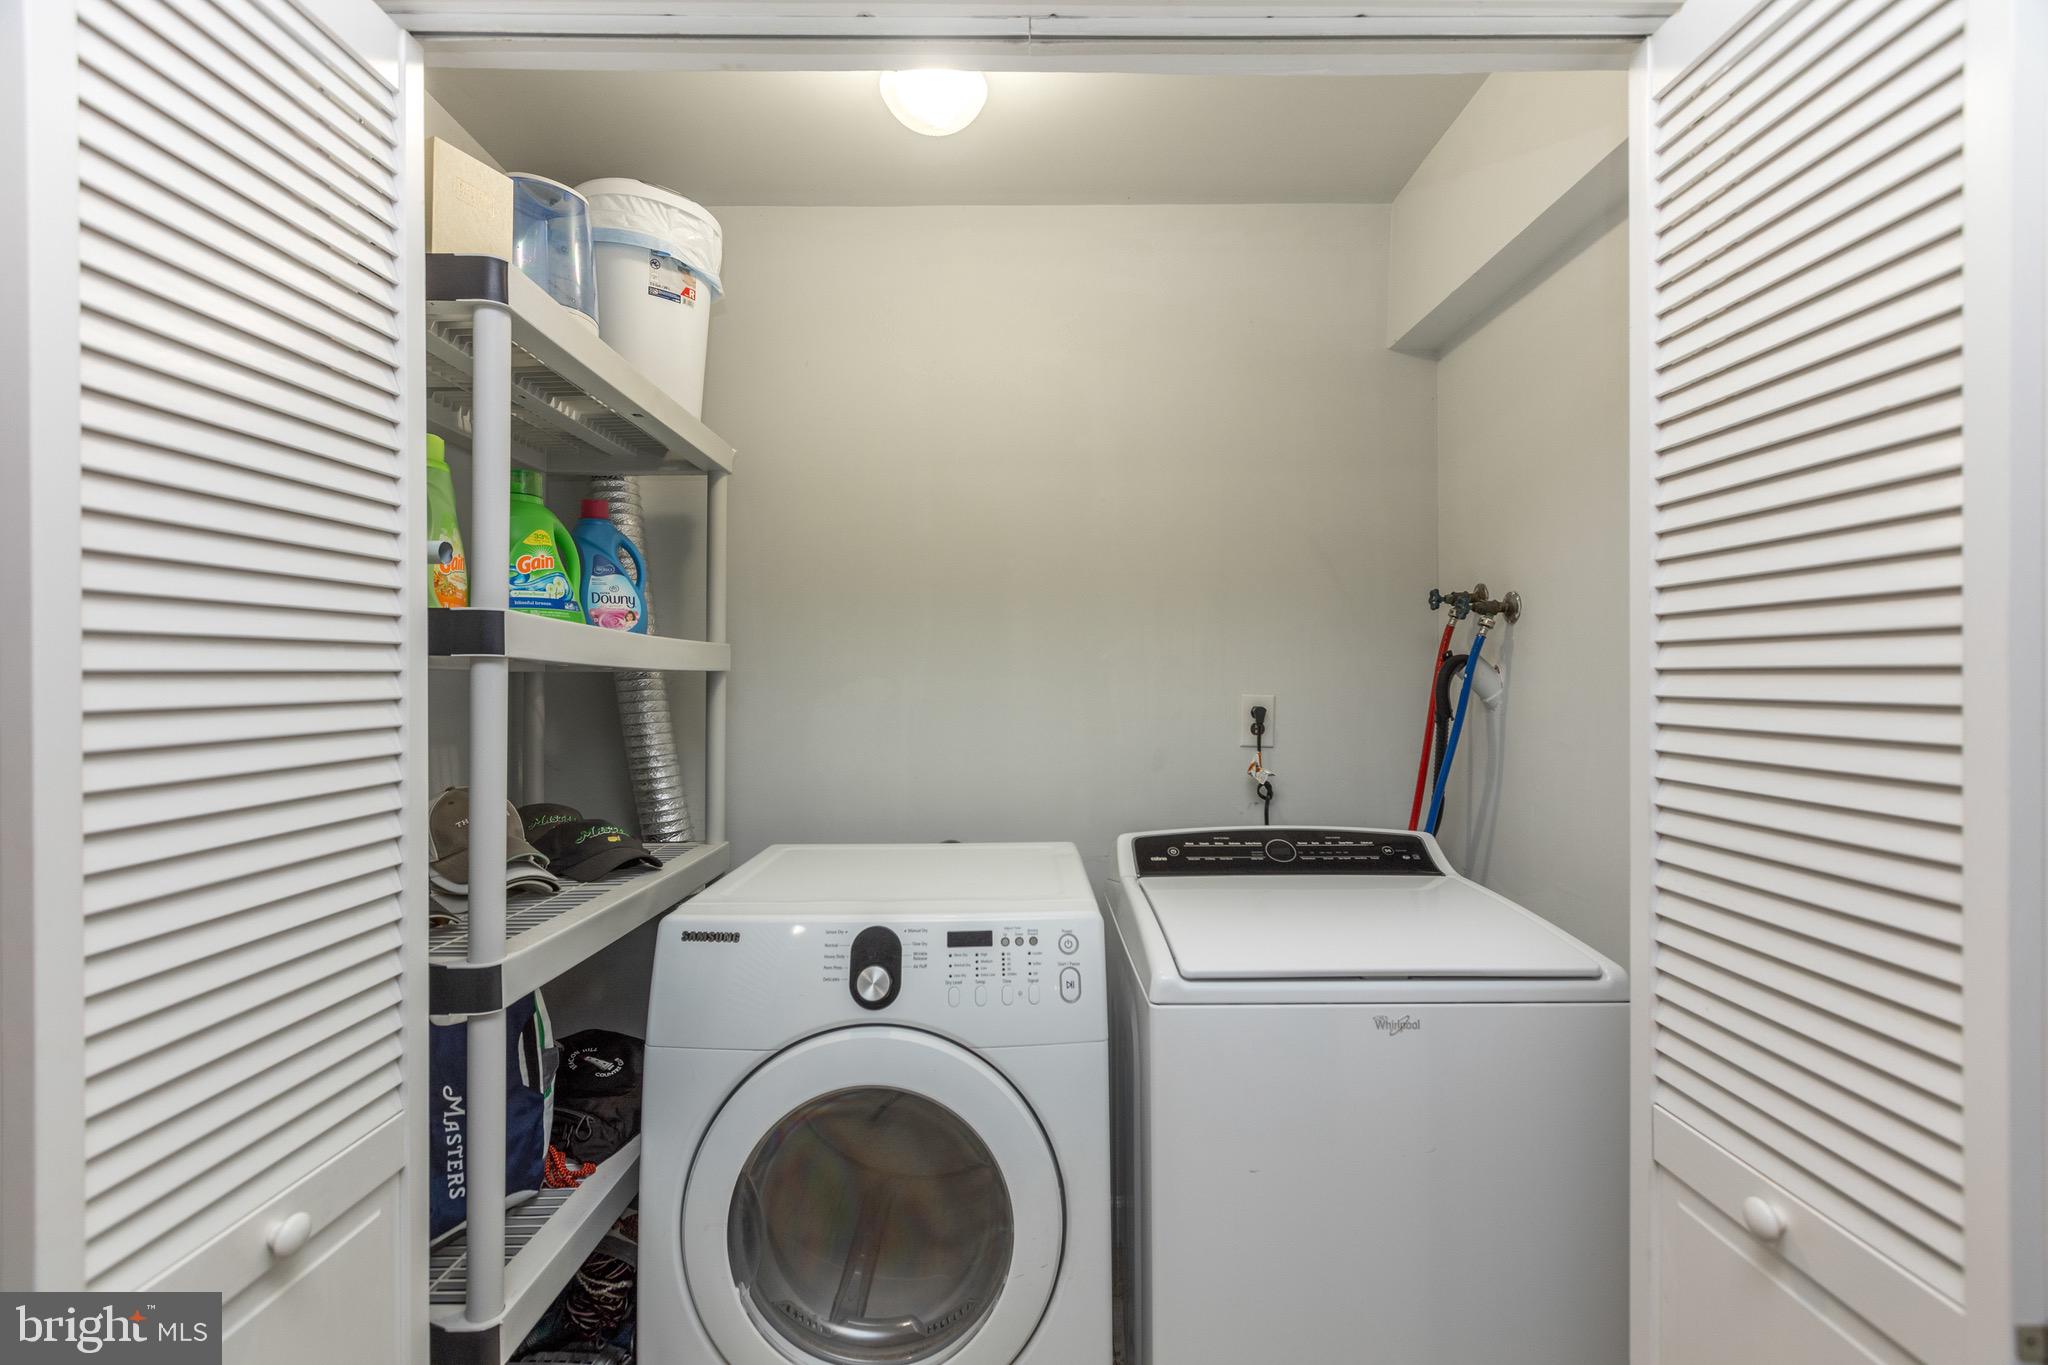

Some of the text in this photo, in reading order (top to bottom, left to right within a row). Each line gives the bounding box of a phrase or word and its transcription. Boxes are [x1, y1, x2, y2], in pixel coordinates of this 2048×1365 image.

[516, 554, 555, 575] Gain
[591, 591, 636, 609] Downy
[681, 930, 741, 944] SAMSUNG
[1372, 1014, 1421, 1036] Whirlpool
